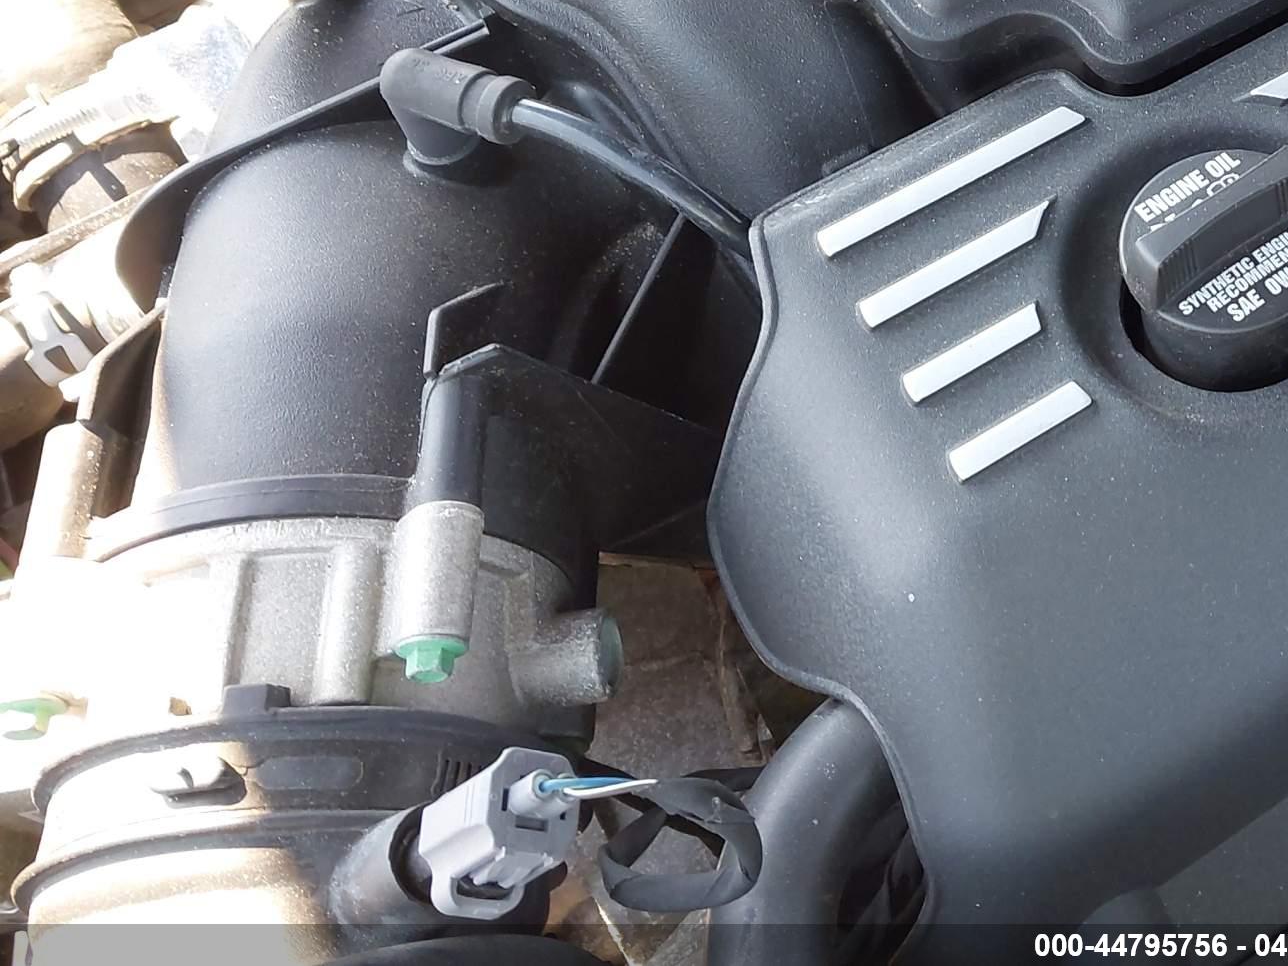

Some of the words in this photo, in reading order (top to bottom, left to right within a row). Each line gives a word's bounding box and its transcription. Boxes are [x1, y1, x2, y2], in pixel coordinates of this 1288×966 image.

[1134, 169, 1210, 222] ENGINE
[1204, 152, 1241, 178] OIL
[1178, 256, 1255, 315] SYNTHETIC
[1226, 288, 1266, 322] SAE
